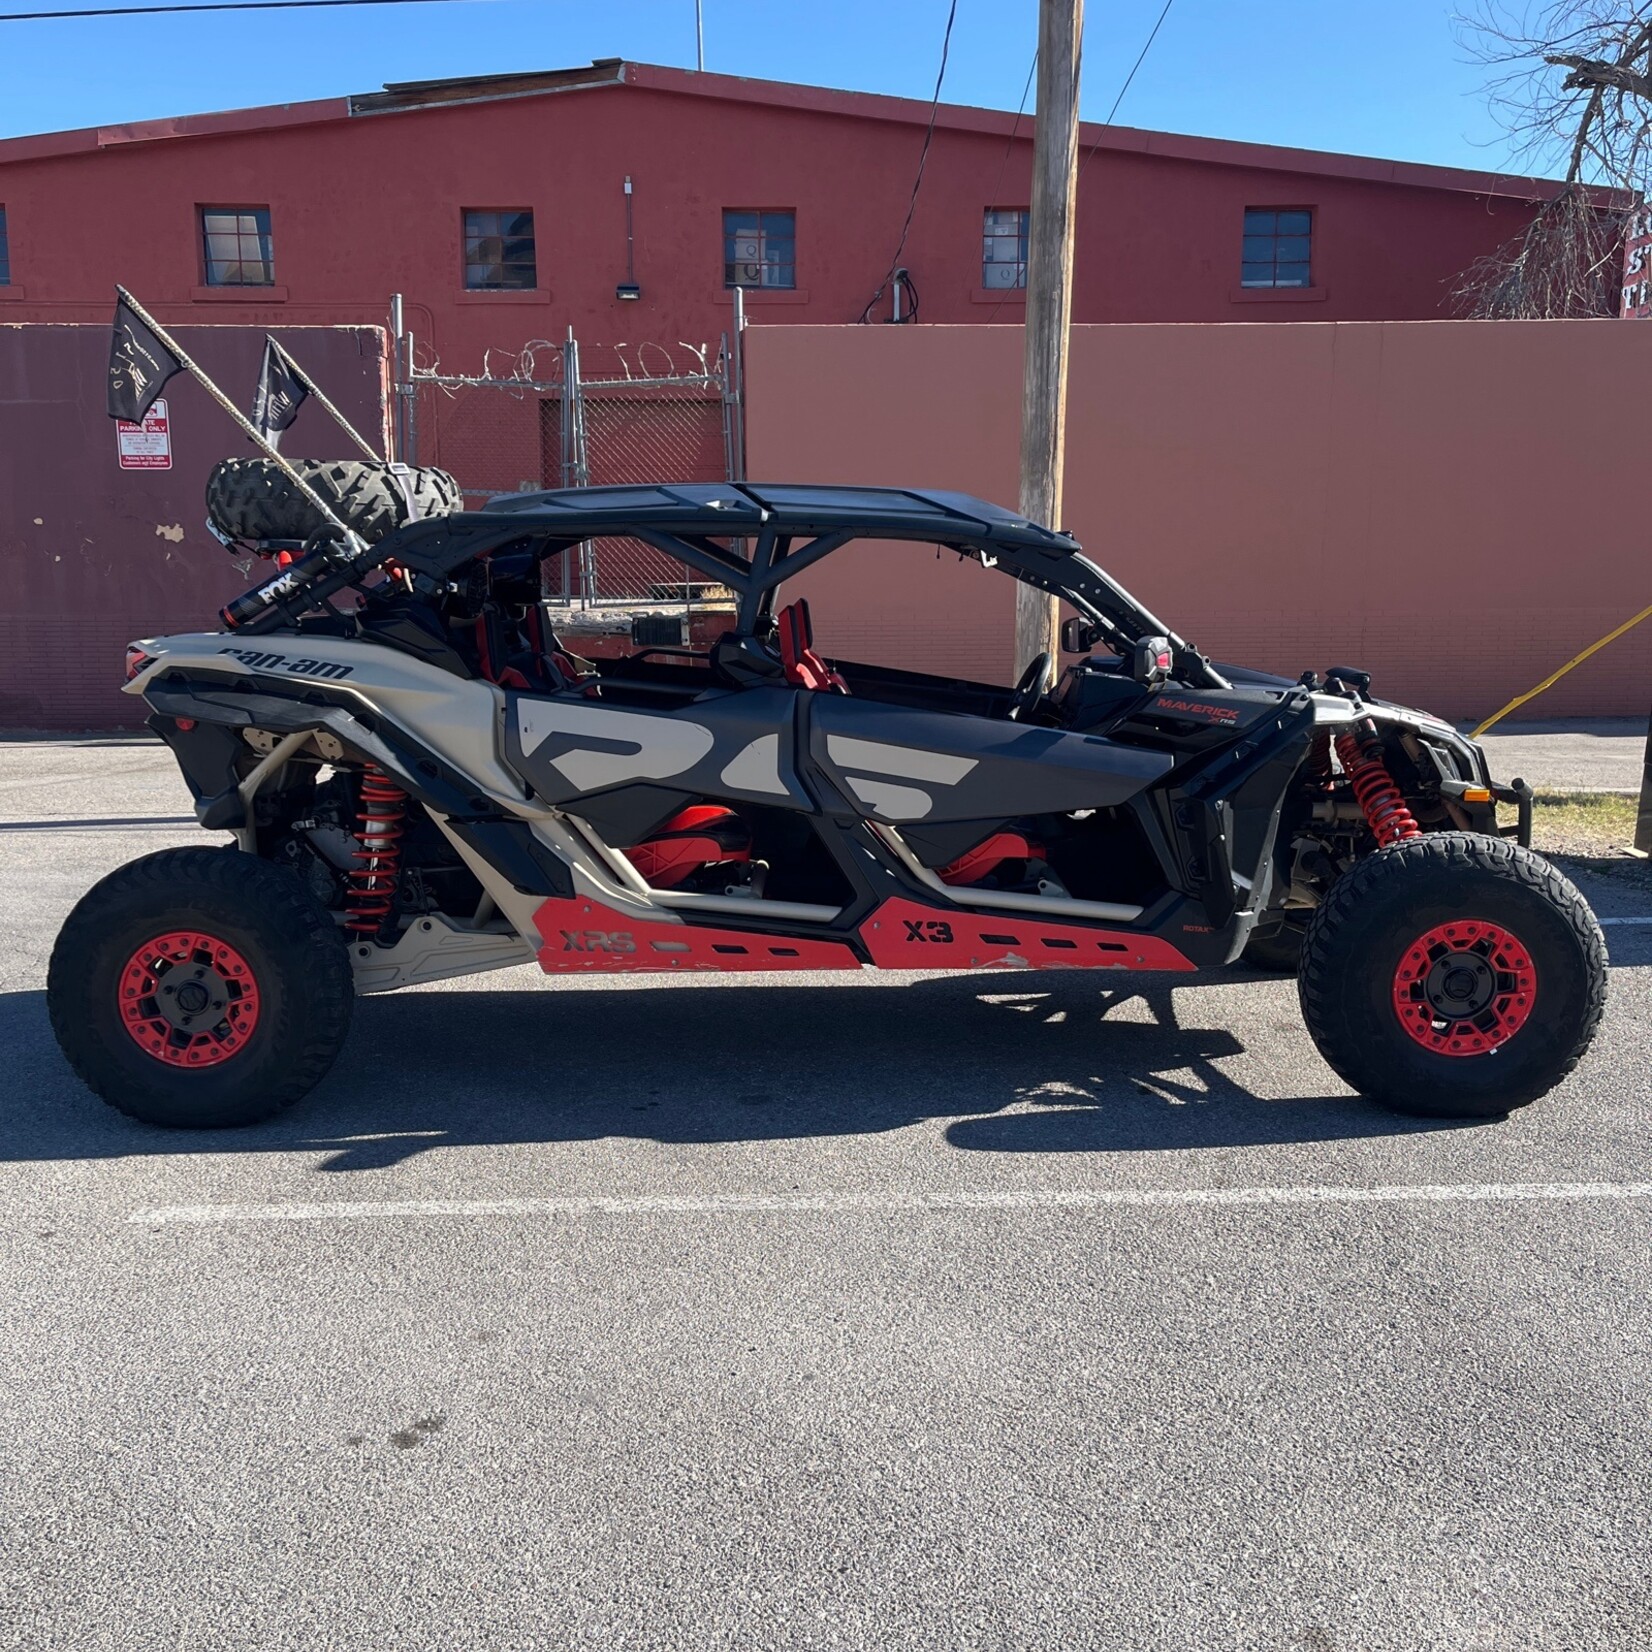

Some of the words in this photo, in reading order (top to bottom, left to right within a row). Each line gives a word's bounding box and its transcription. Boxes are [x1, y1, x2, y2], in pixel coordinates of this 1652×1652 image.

[258, 572, 299, 605] FOX
[1156, 697, 1240, 719] MAVERICK
[559, 929, 637, 953] XRS
[902, 919, 954, 943] X3
[1182, 924, 1209, 934] ROTAX
